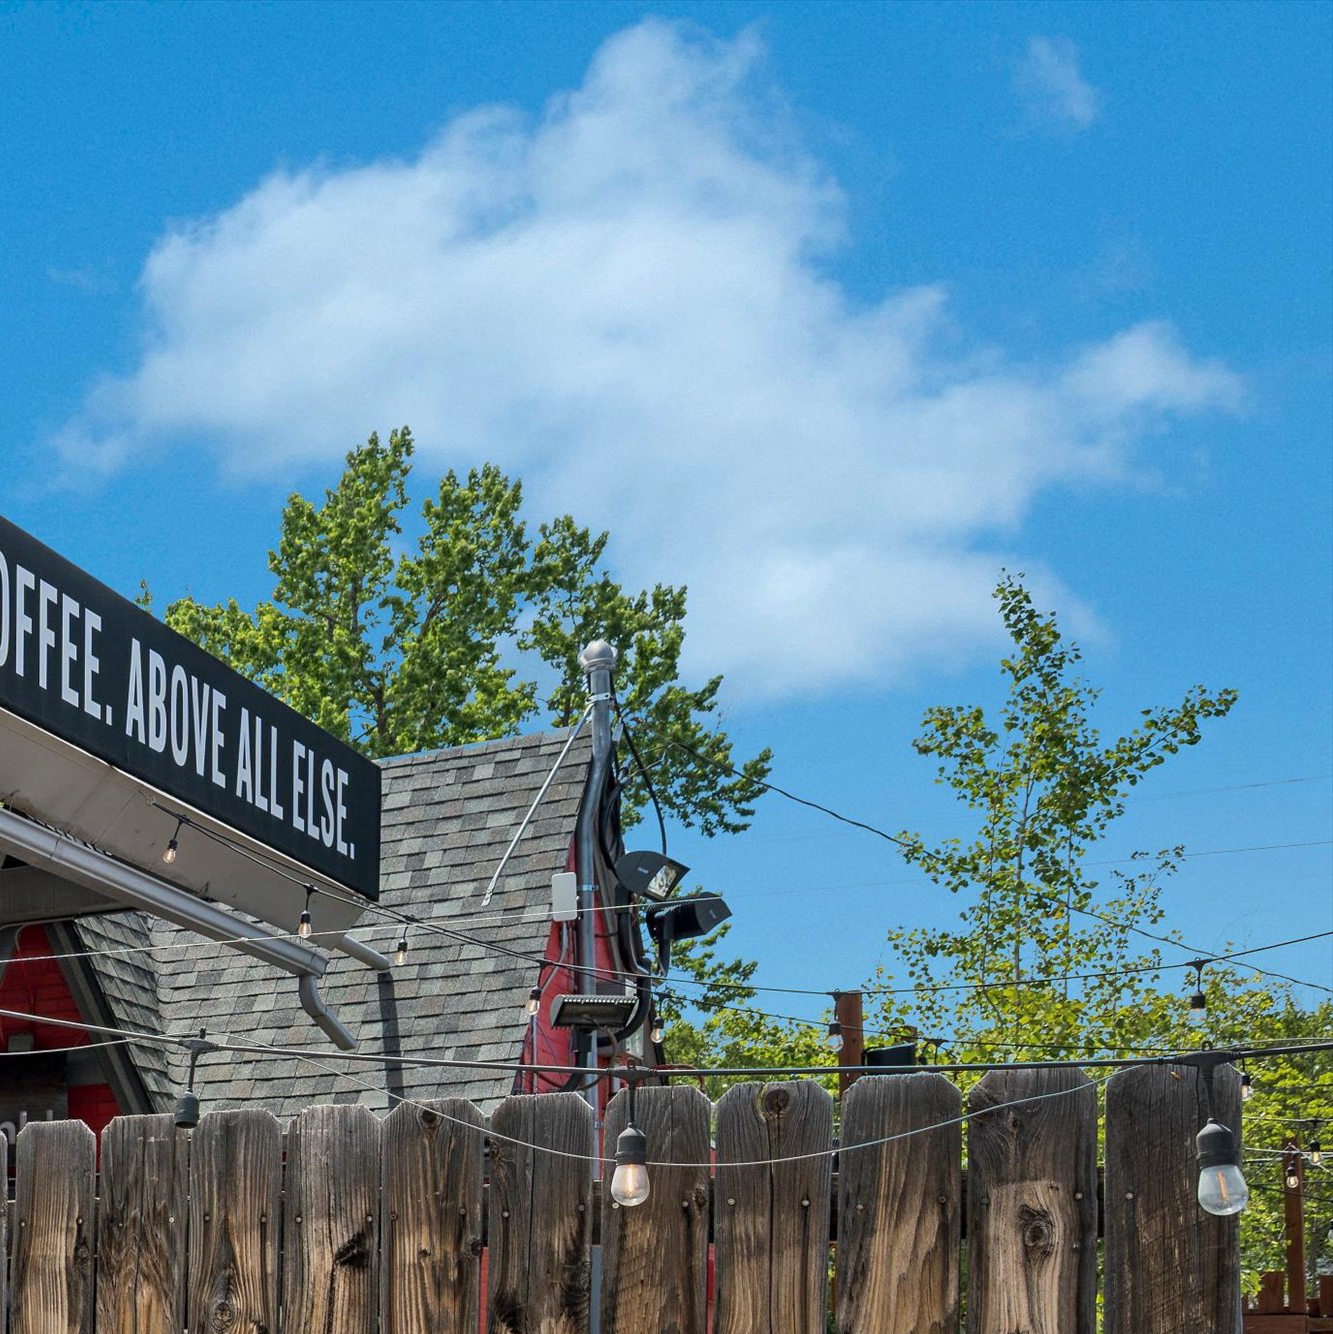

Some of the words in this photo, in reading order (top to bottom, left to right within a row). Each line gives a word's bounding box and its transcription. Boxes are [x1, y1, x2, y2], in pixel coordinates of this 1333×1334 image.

[125, 637, 227, 790] ABOVE
[236, 707, 284, 821] ALL
[291, 739, 355, 861] ELSE.
